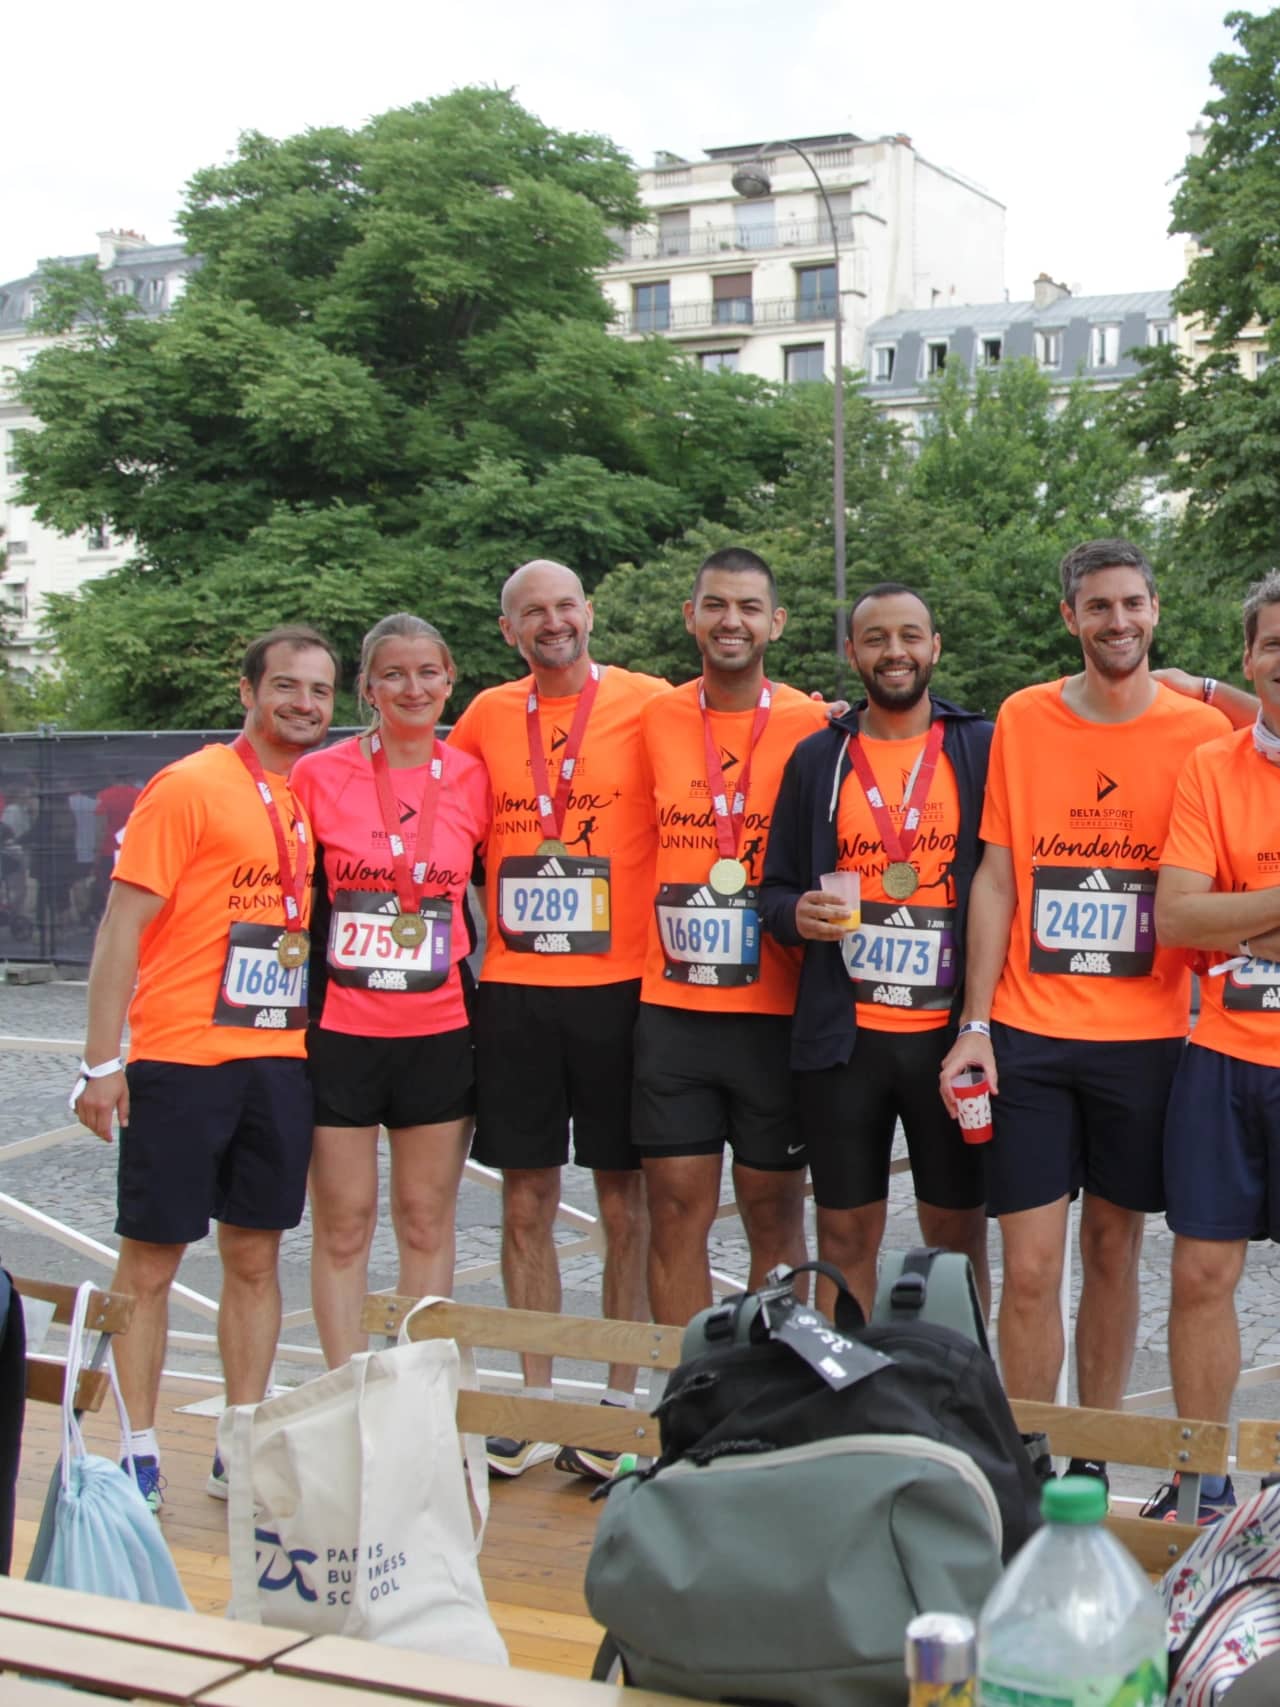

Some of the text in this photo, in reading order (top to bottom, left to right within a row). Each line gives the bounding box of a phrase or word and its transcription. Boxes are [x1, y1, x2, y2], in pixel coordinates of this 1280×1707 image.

[1069, 808, 1135, 819] DELTA SPORT
[1032, 832, 1161, 861] Wonderbox
[514, 887, 579, 921] 9289
[666, 916, 731, 954] 16891
[1045, 900, 1128, 941] 24217
[850, 932, 930, 976] 24173
[1069, 961, 1112, 974] PARIS
[1085, 951, 1111, 963] 10K
[328, 1552, 407, 1584] BUINESS
[327, 1577, 401, 1606] SCOOL
